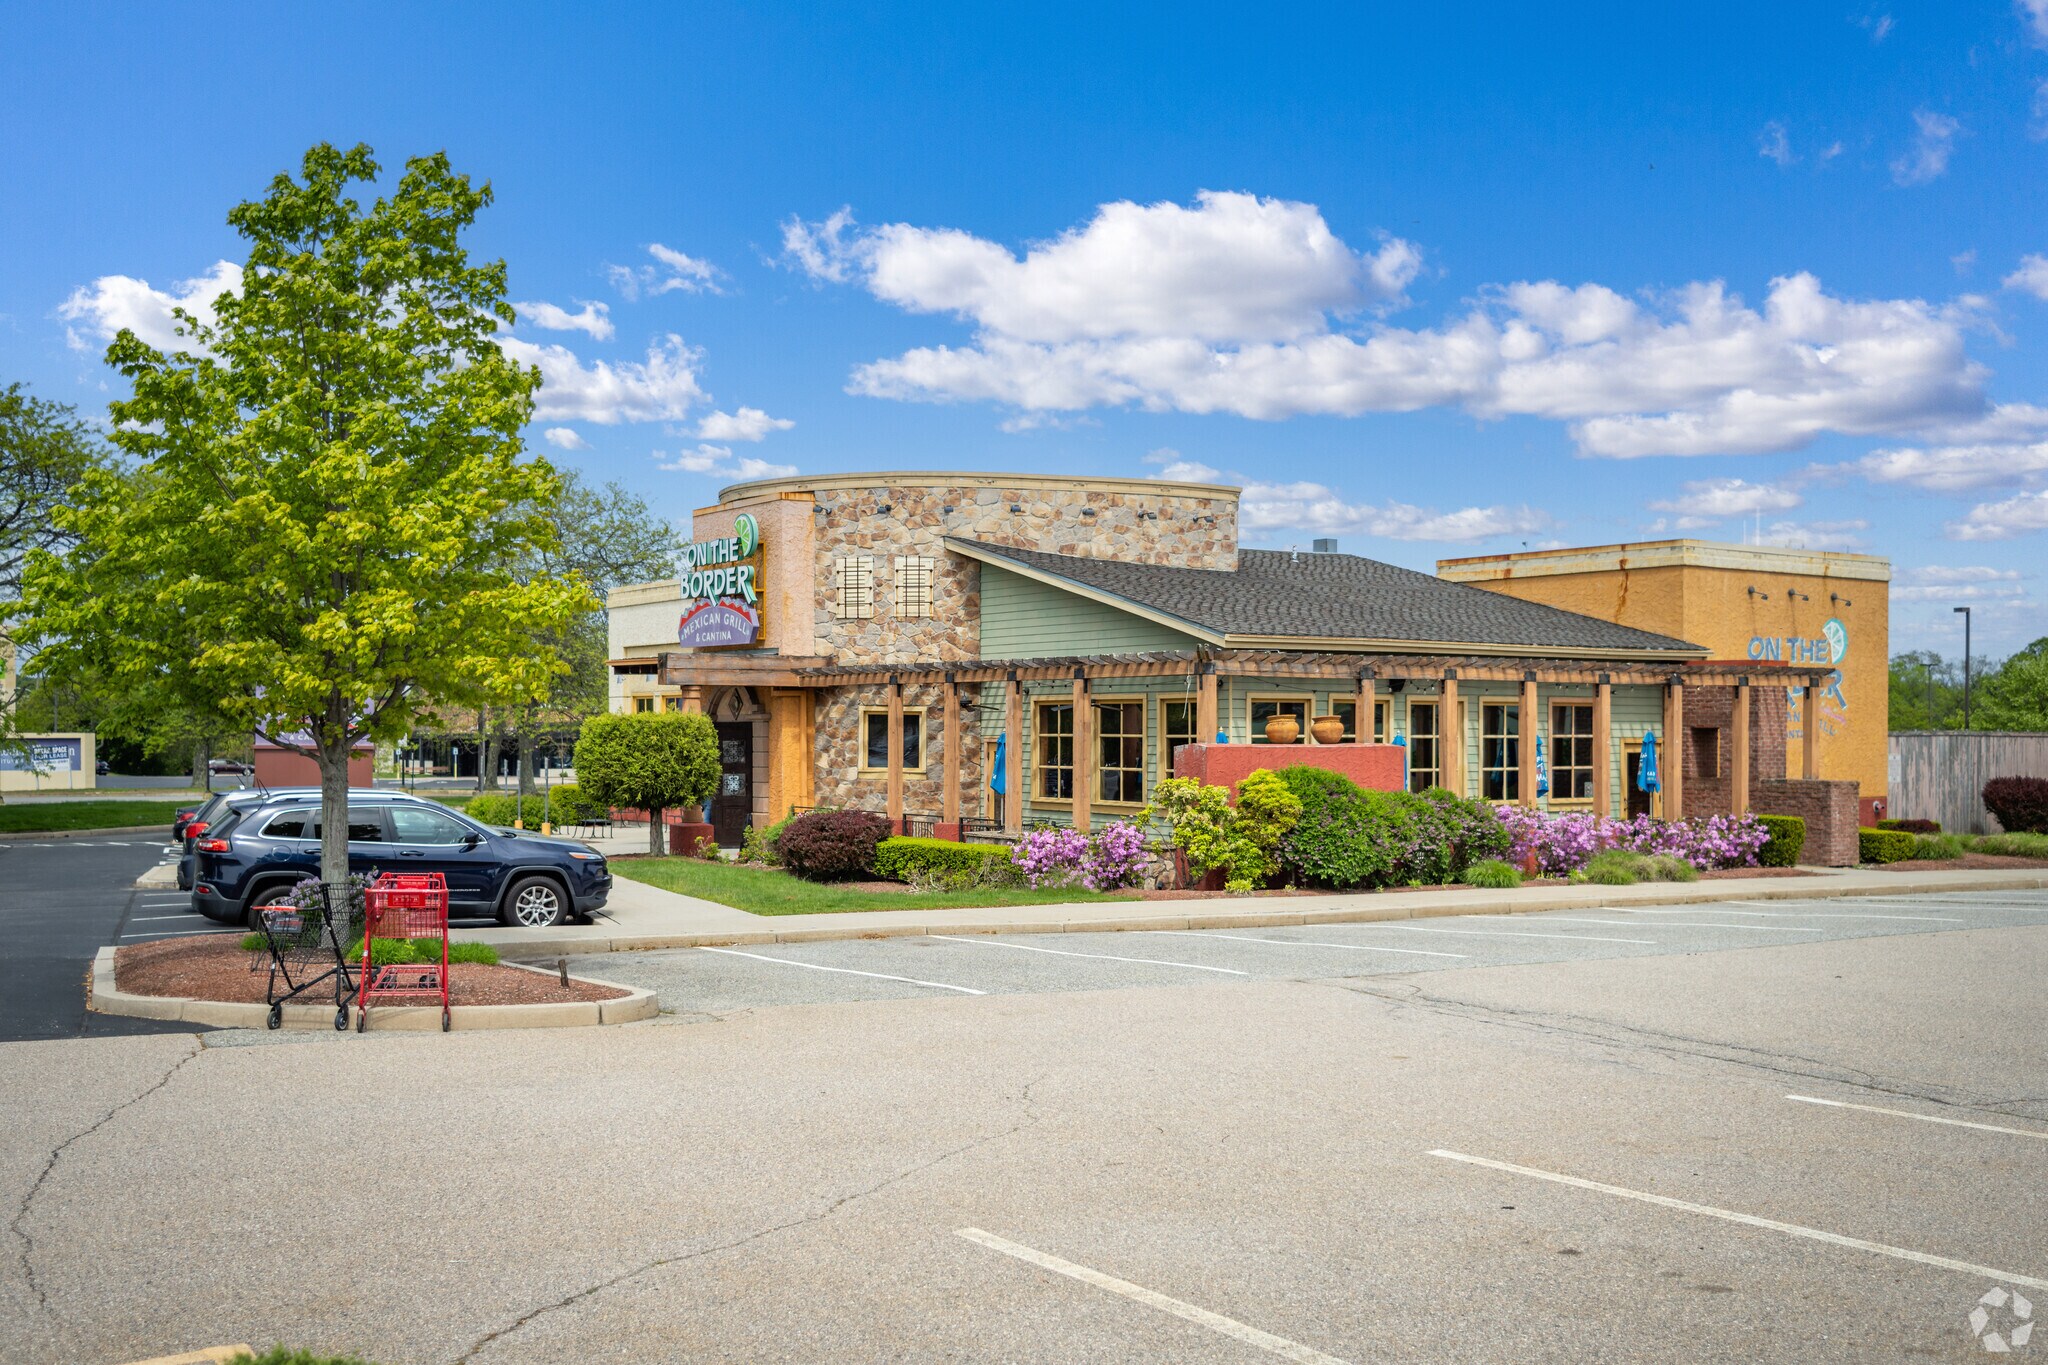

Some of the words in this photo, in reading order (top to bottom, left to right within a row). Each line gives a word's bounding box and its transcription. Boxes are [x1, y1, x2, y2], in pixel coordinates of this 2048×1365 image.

[686, 542, 709, 567] ON
[710, 537, 741, 564] THE
[680, 565, 756, 607] BORDER
[683, 612, 721, 639] MEXICAN
[723, 613, 747, 635] GRILL
[695, 632, 700, 642] &
[701, 630, 732, 642] CANTINA
[1747, 636, 1781, 661] ON
[1786, 637, 1829, 664] THE
